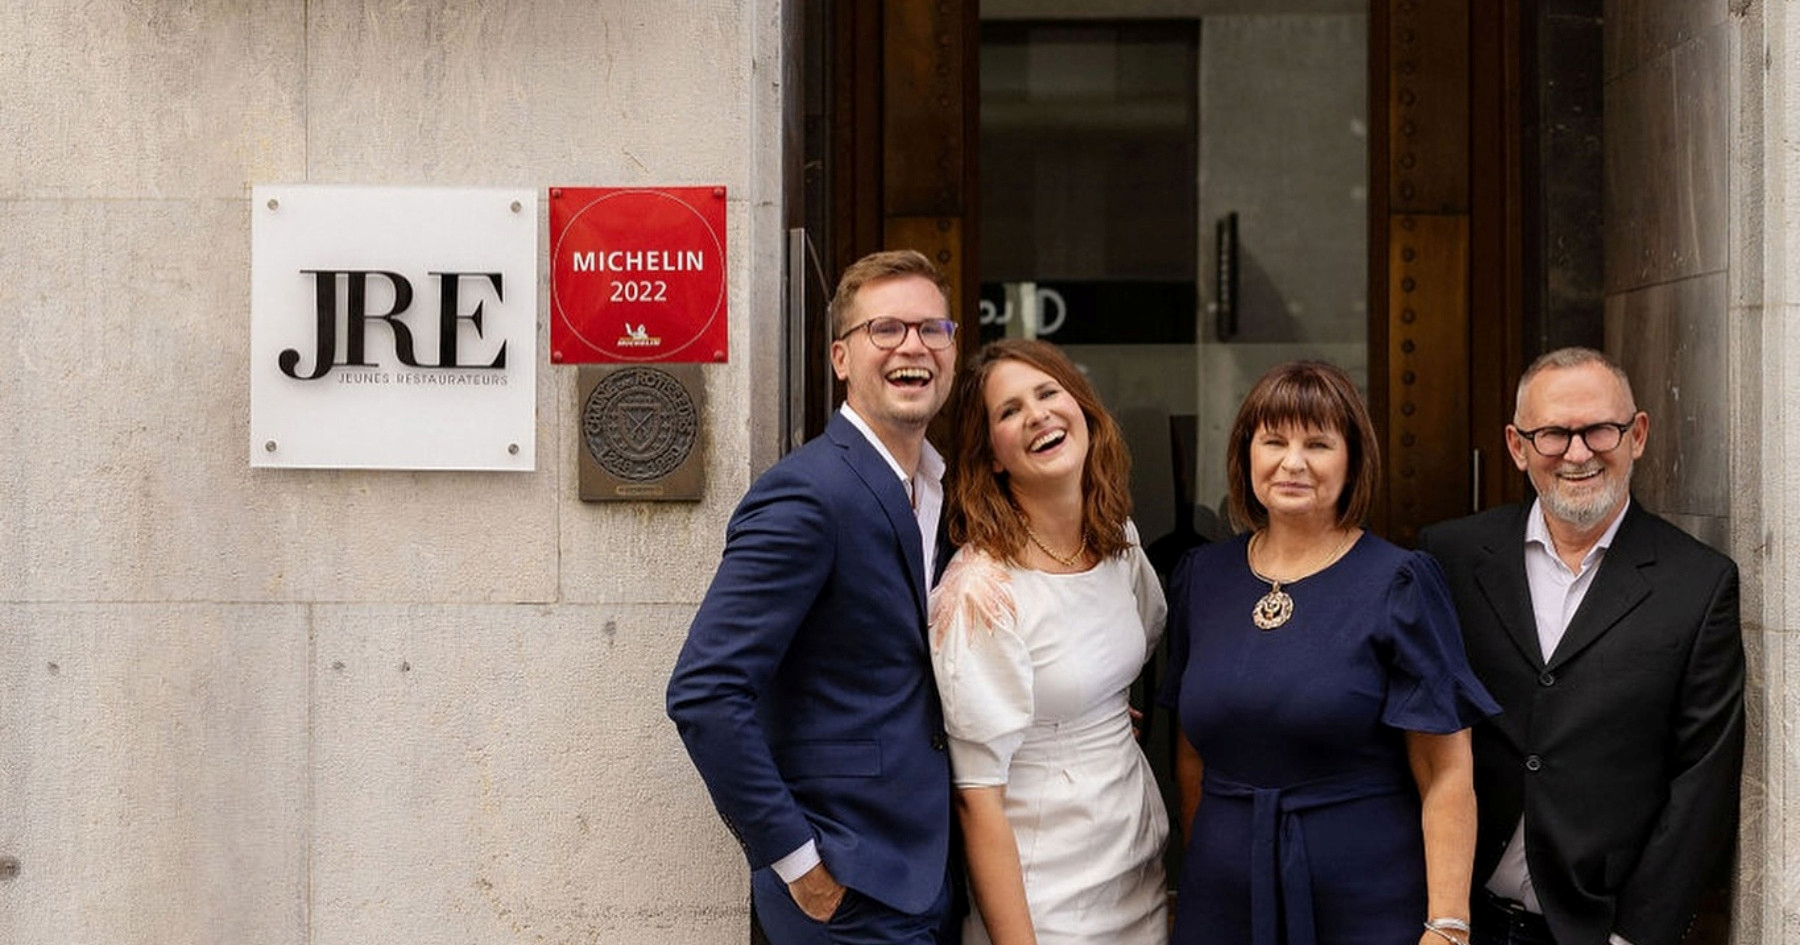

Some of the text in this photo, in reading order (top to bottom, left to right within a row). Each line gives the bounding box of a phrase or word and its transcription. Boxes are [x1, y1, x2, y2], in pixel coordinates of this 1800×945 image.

[573, 251, 704, 272] MICHELIN
[610, 280, 667, 302] 2022
[278, 270, 507, 380] JRE
[338, 373, 508, 385] JEUNES RESTAURATEURS
